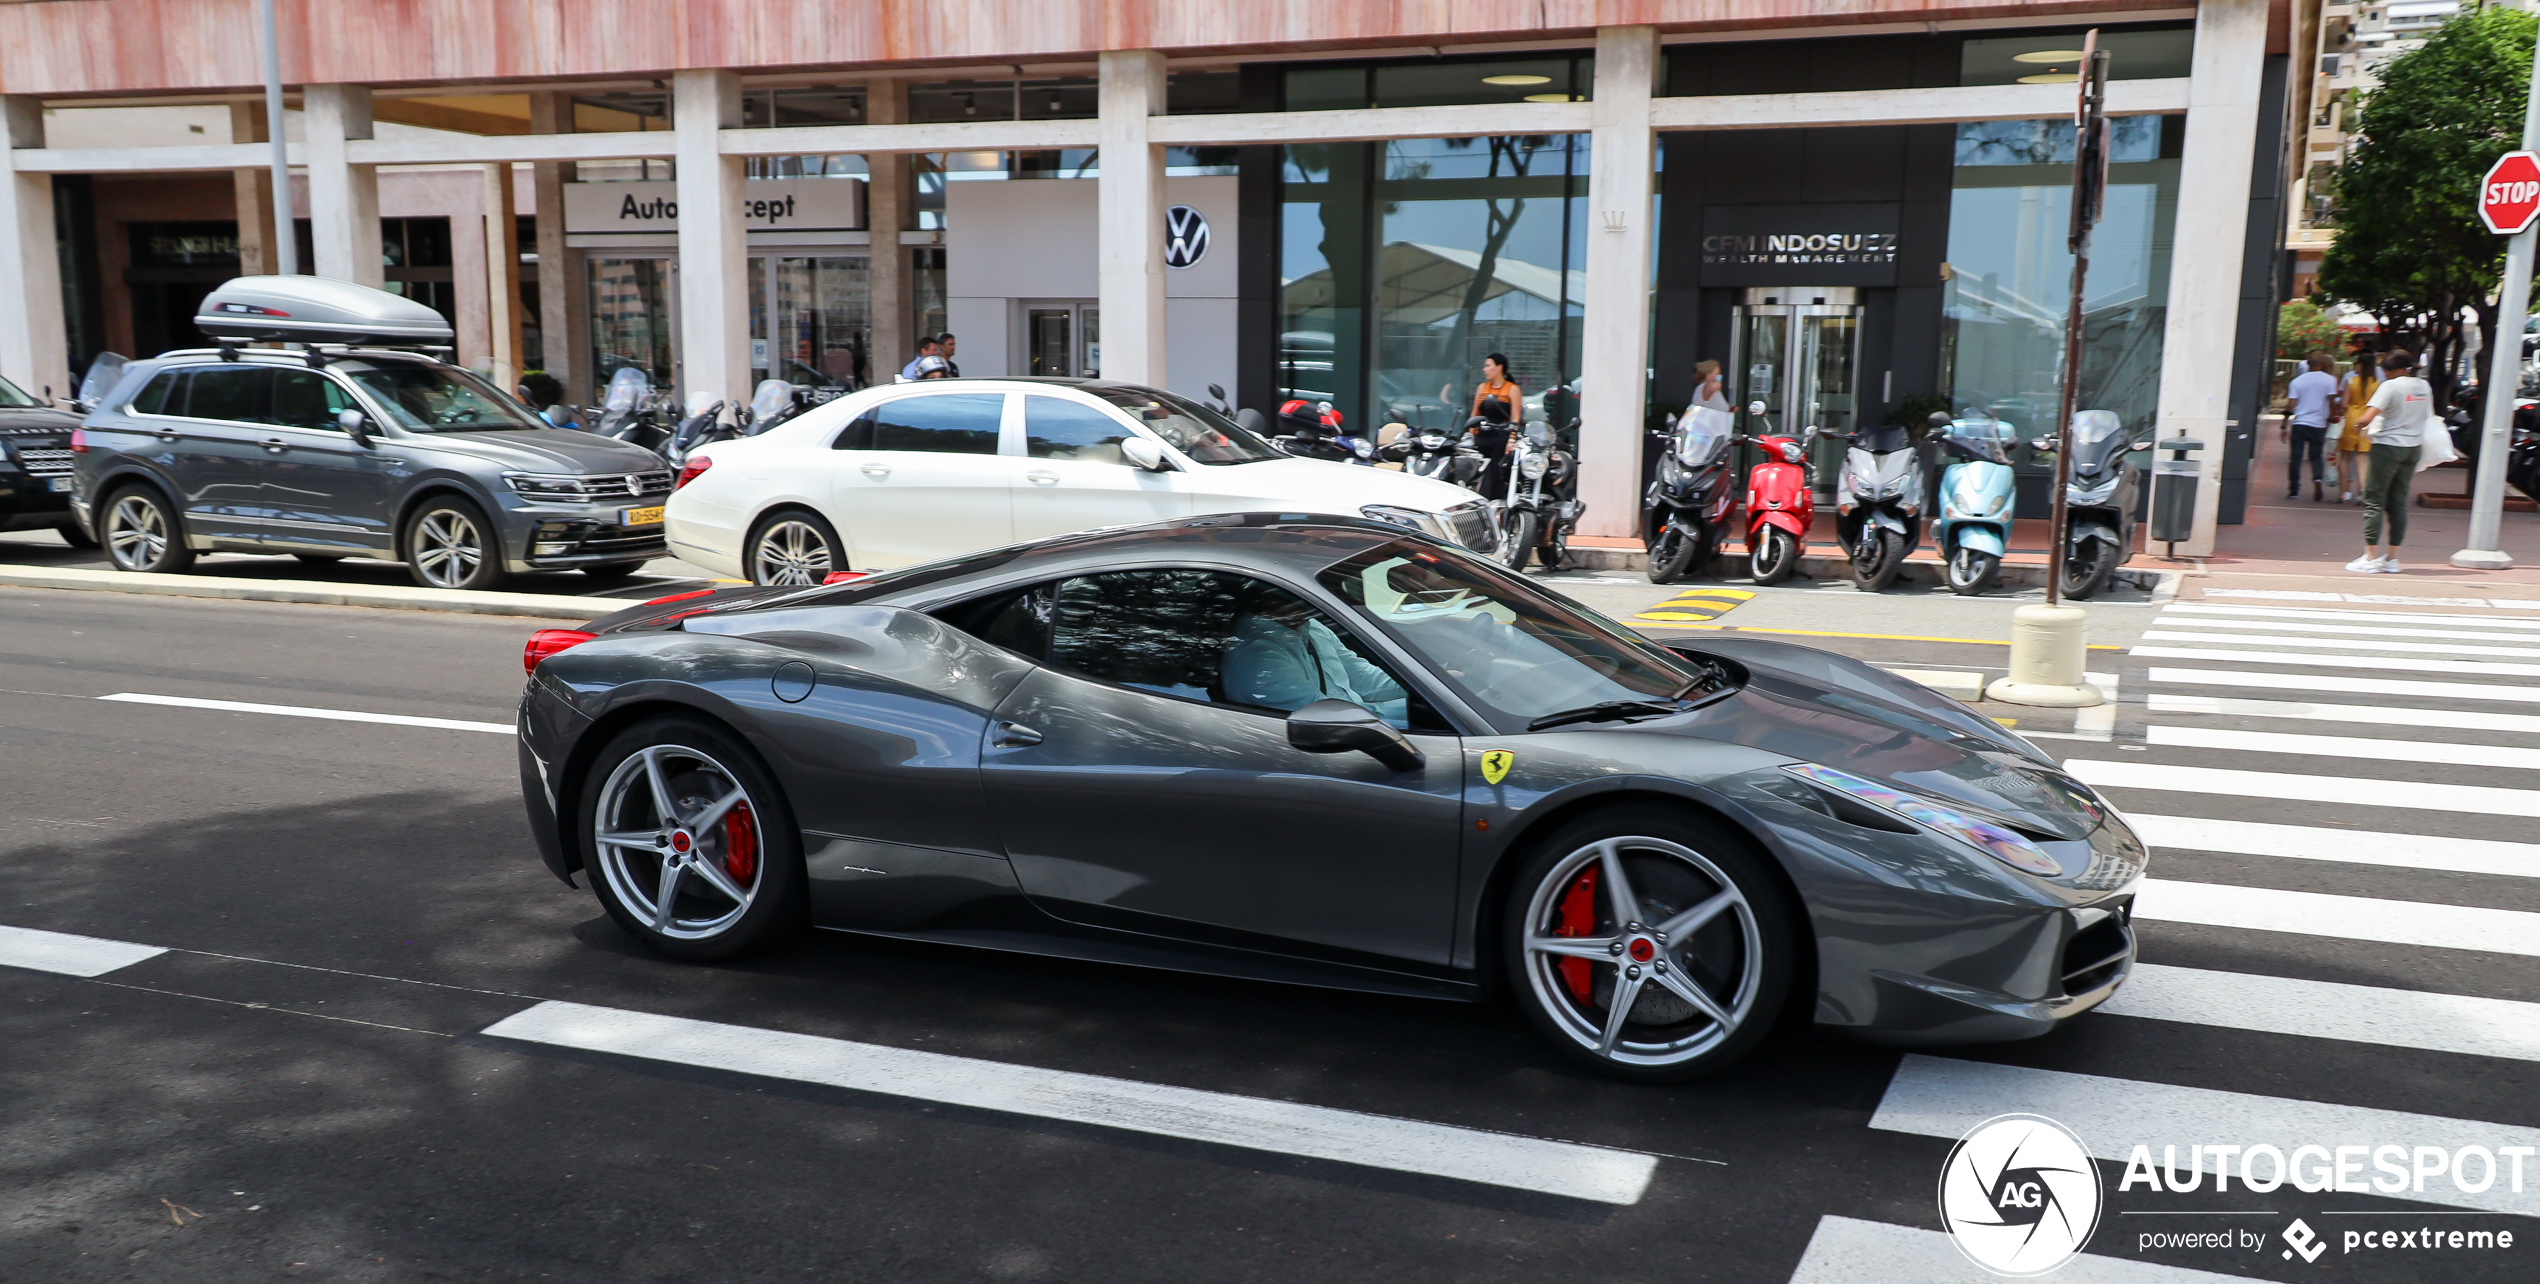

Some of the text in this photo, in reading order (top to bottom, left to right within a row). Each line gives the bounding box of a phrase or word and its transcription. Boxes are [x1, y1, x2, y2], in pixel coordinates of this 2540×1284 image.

[2486, 180, 2540, 205] STOP
[1702, 233, 1898, 252] CFM INDOSUEZ
[1702, 253, 1897, 264] WEALTH MANAGEMENT
